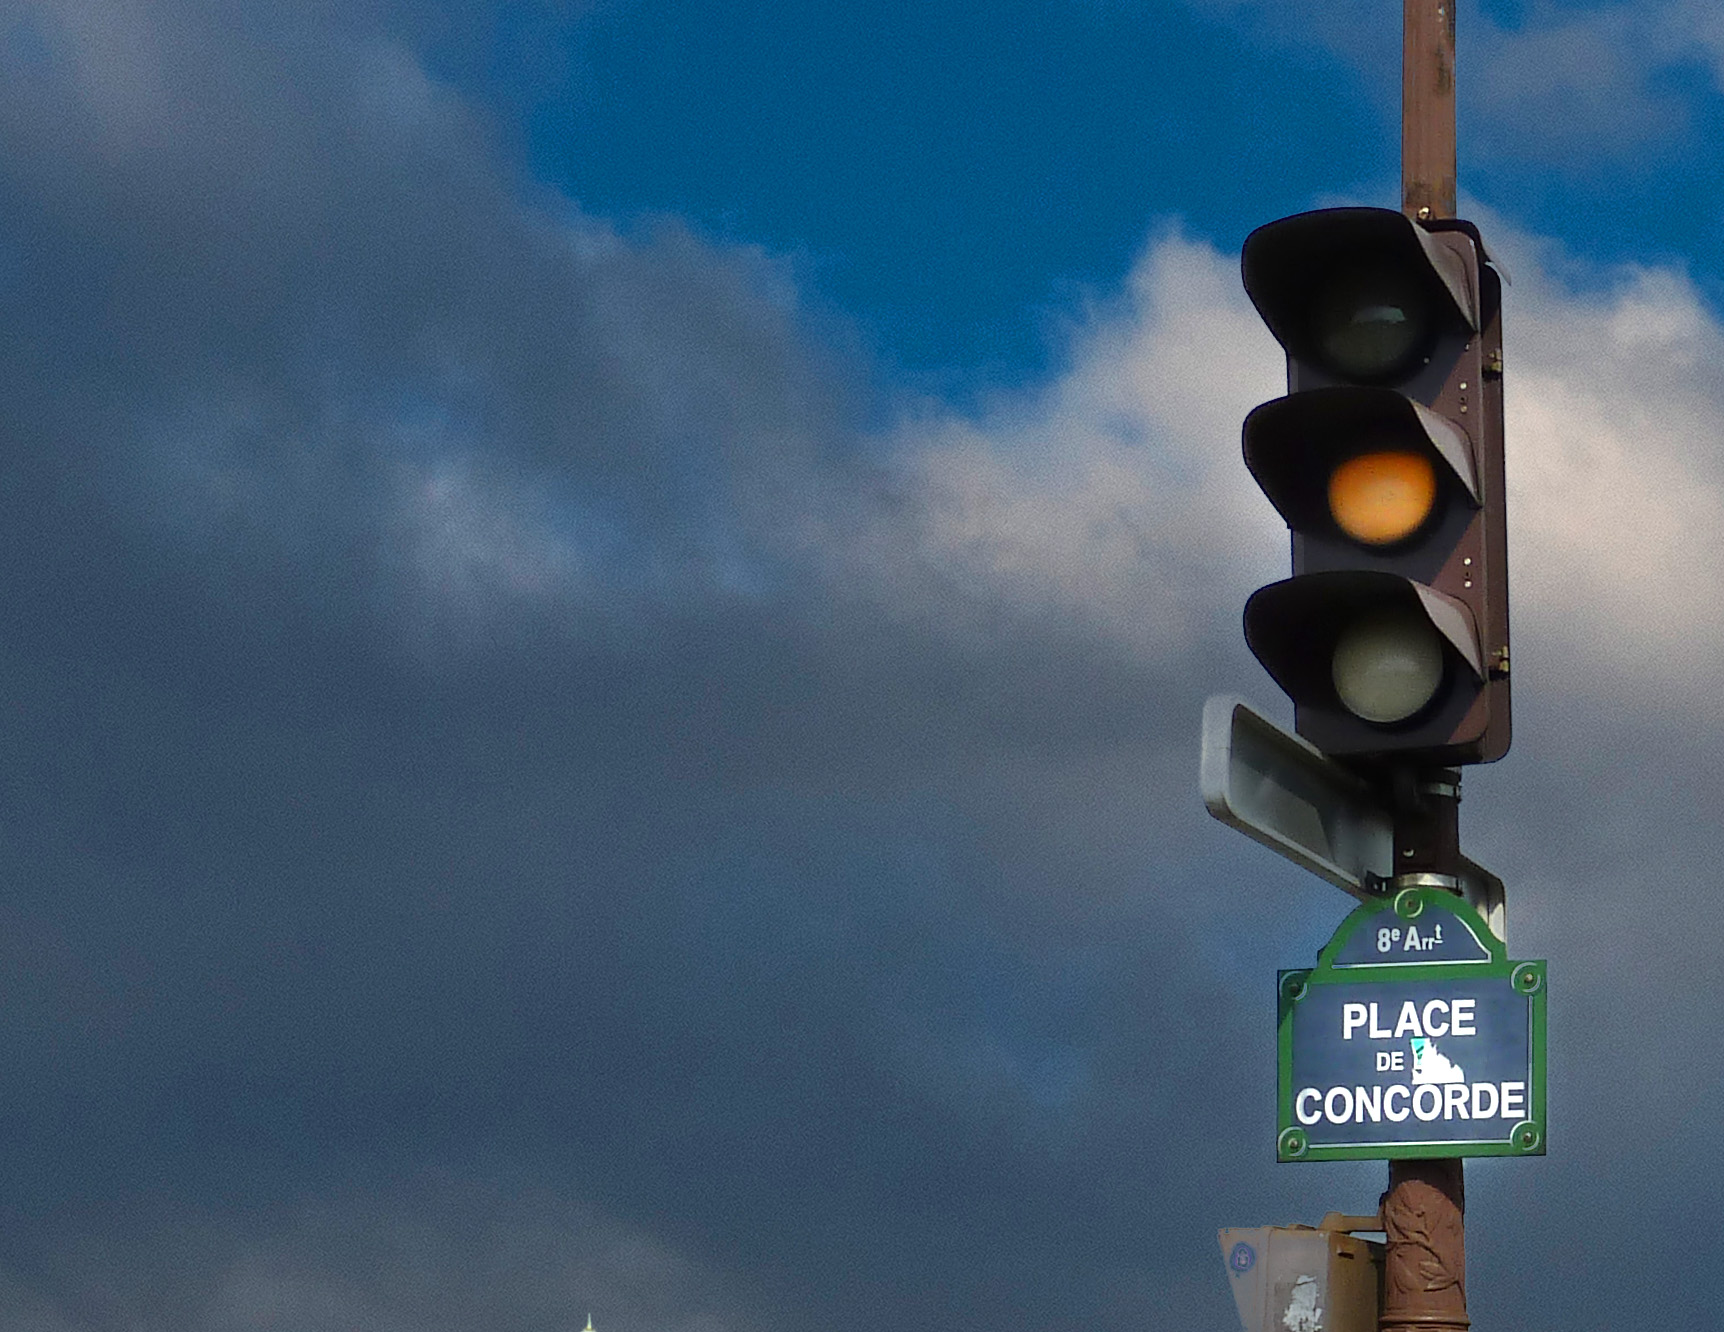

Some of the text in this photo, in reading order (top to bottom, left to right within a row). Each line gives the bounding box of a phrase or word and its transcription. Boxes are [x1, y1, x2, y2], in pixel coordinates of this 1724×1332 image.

[1343, 999, 1476, 1040] PLACE
[1376, 1051, 1404, 1072] DE
[1296, 1081, 1526, 1126] CONCORDE
